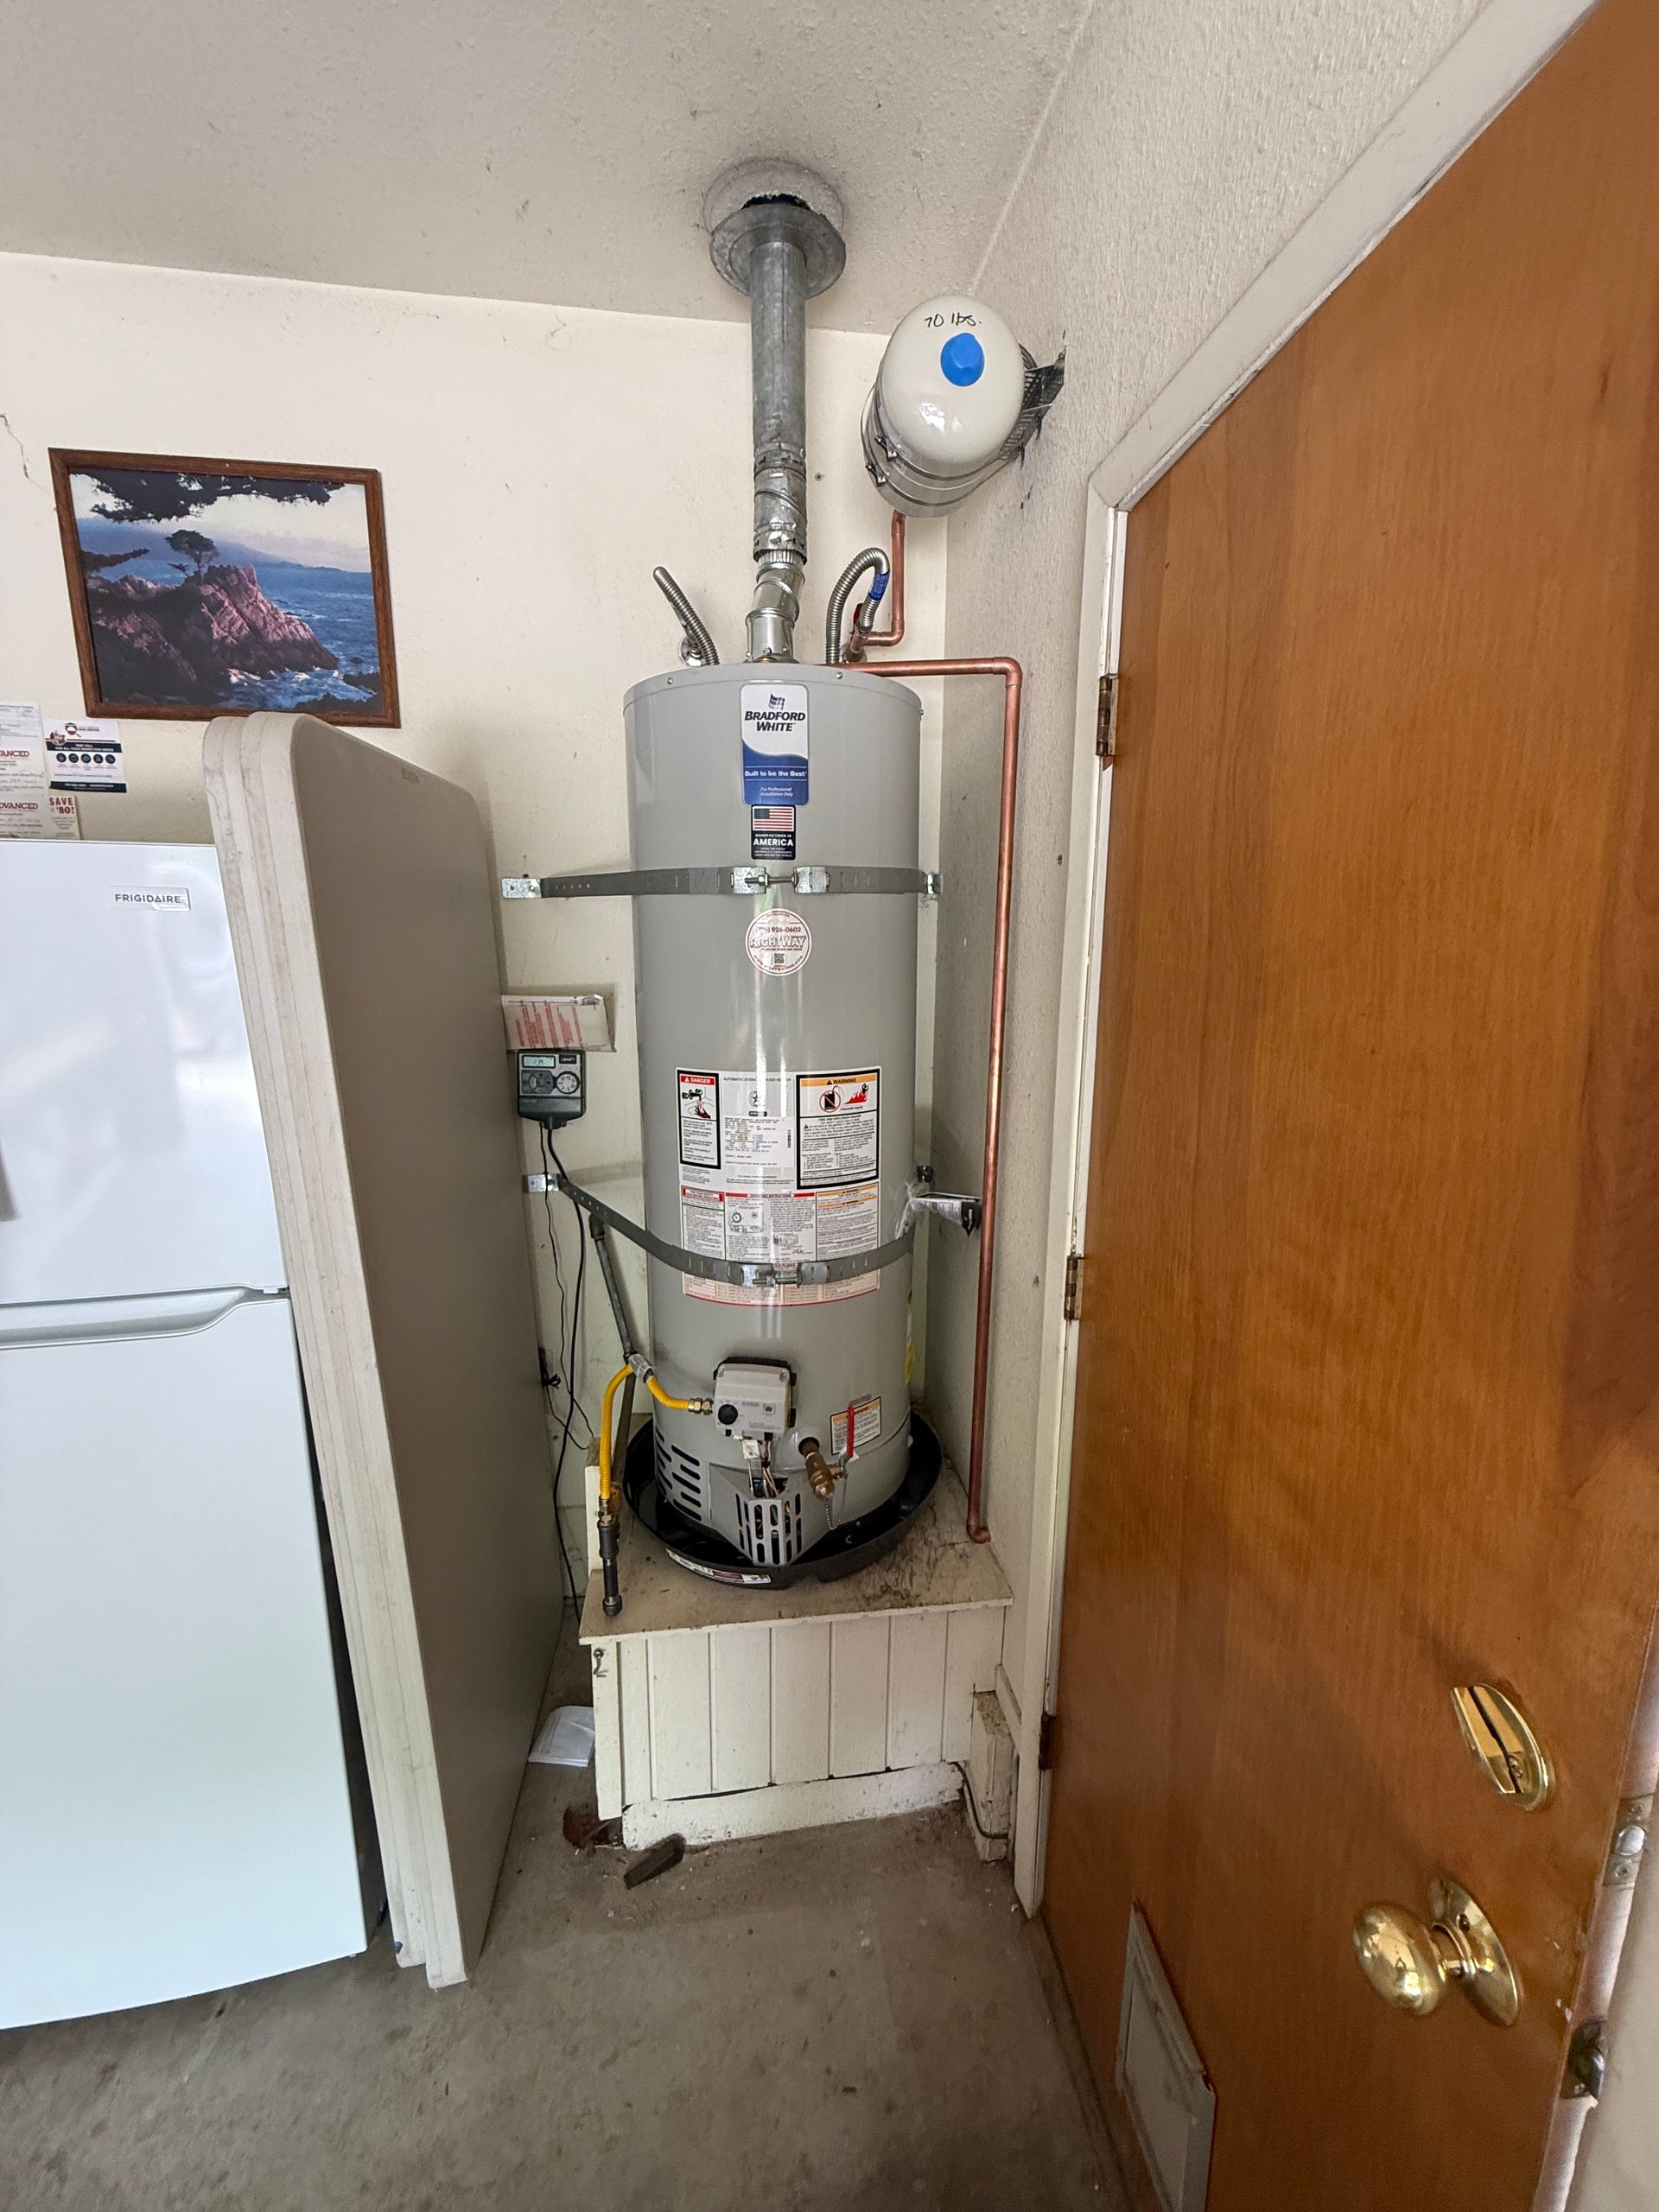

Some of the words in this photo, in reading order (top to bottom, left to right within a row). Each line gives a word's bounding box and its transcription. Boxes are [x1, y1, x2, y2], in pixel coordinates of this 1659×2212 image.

[924, 314, 944, 327] 70
[745, 711, 806, 721] BRADFORD
[757, 721, 793, 731] WHITE
[115, 893, 181, 904] FRIGIDAIRE
